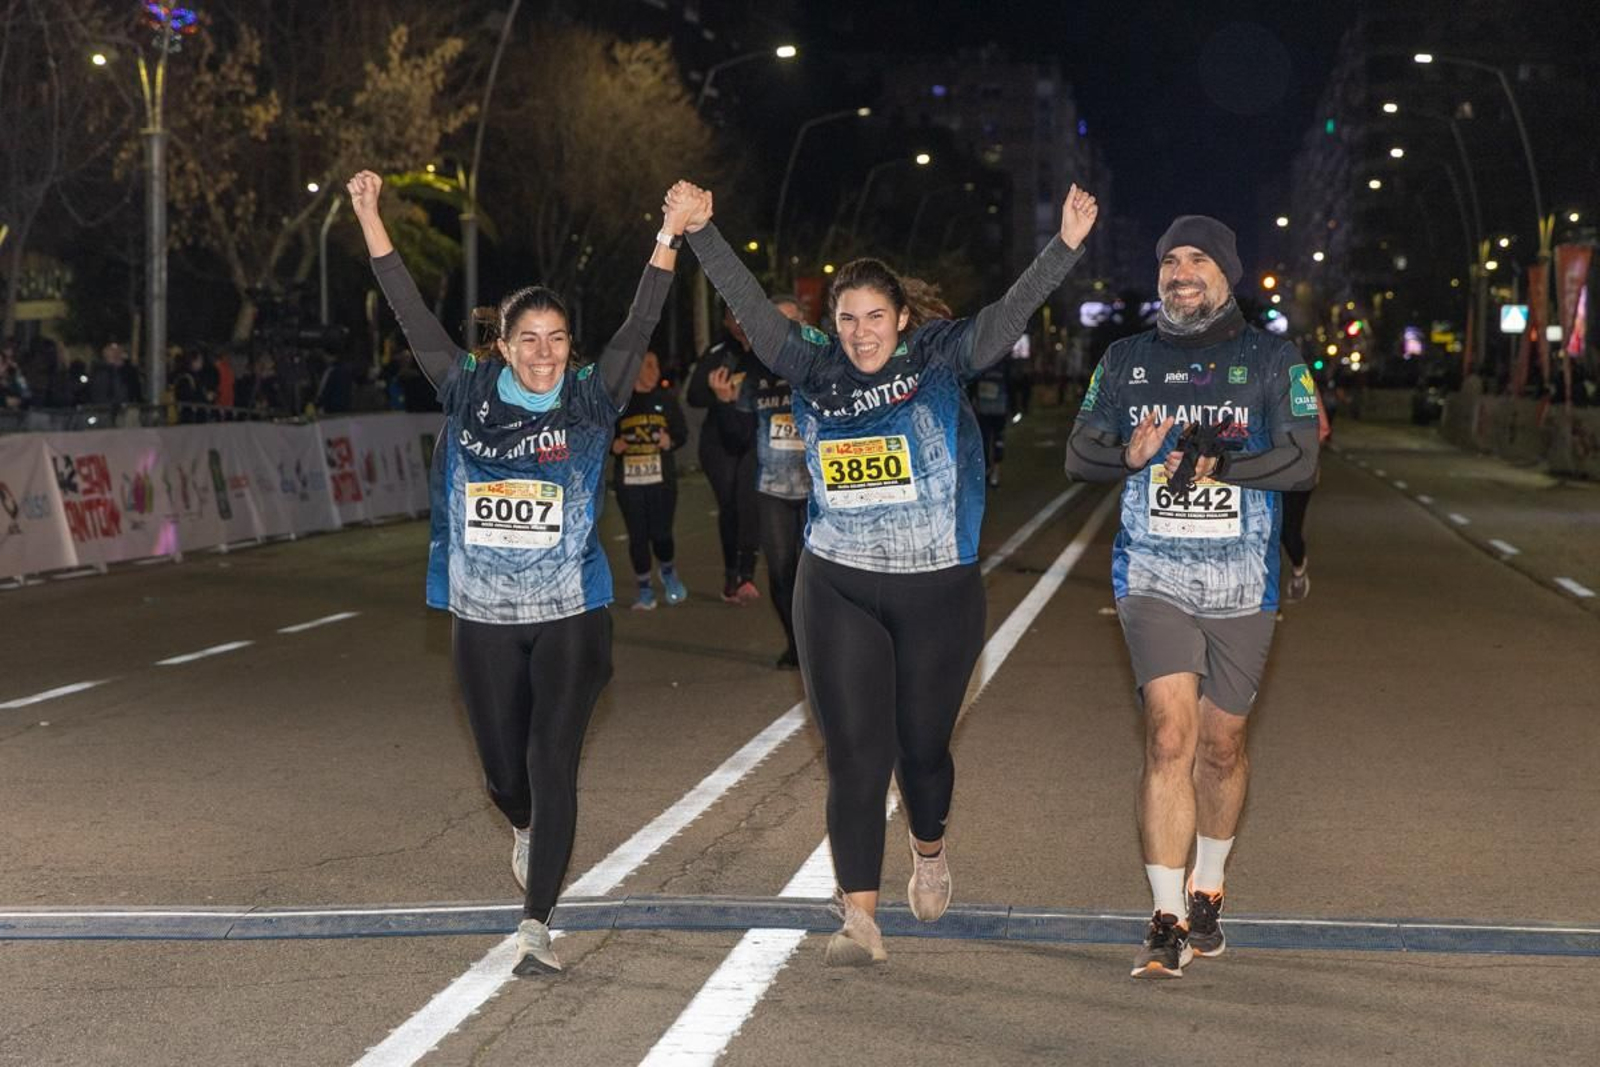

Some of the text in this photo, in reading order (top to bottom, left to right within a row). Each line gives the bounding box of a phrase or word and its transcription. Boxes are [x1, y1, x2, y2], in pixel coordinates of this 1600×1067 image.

[1129, 400, 1249, 427] SAN ANTÓN
[459, 429, 497, 458] SAN
[828, 455, 902, 483] 3850
[476, 497, 554, 523] 6007
[1156, 486, 1233, 511] 6442
